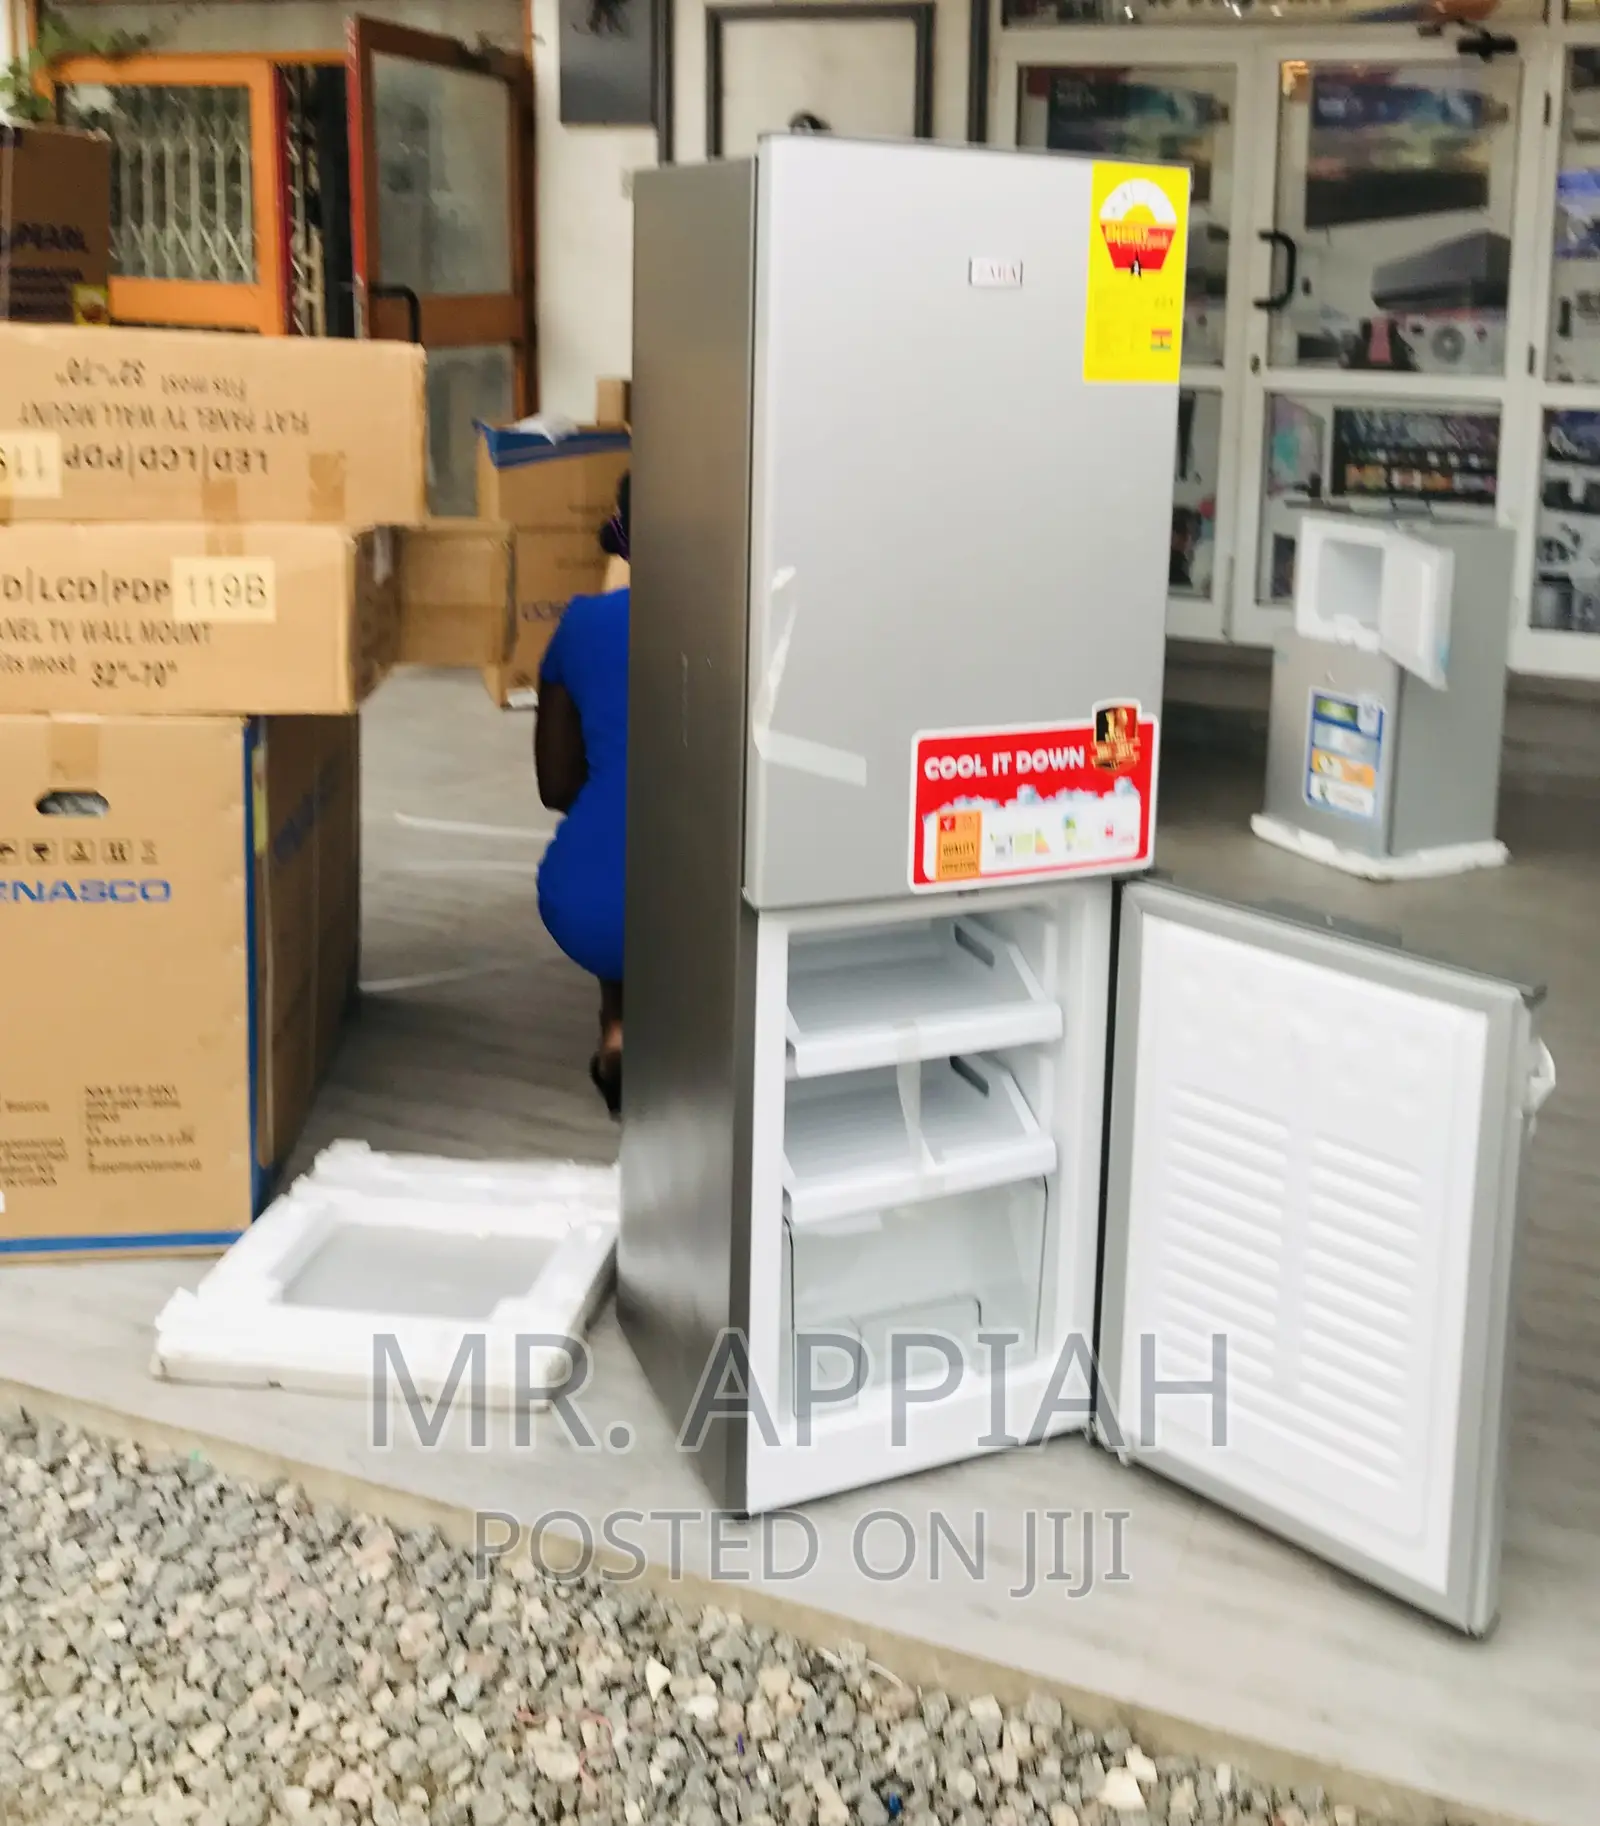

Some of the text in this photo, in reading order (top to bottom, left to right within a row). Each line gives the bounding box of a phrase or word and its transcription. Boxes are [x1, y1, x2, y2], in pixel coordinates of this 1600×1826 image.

[18, 400, 309, 434] FLAT PANEL TV WALL MOUNT
[187, 572, 267, 608] 119B
[47, 618, 75, 643] TV
[80, 619, 134, 644] WALL
[138, 620, 213, 645] MOUNT
[924, 754, 987, 781] COOL
[992, 751, 1012, 776] IT
[1016, 745, 1084, 775] DOWN
